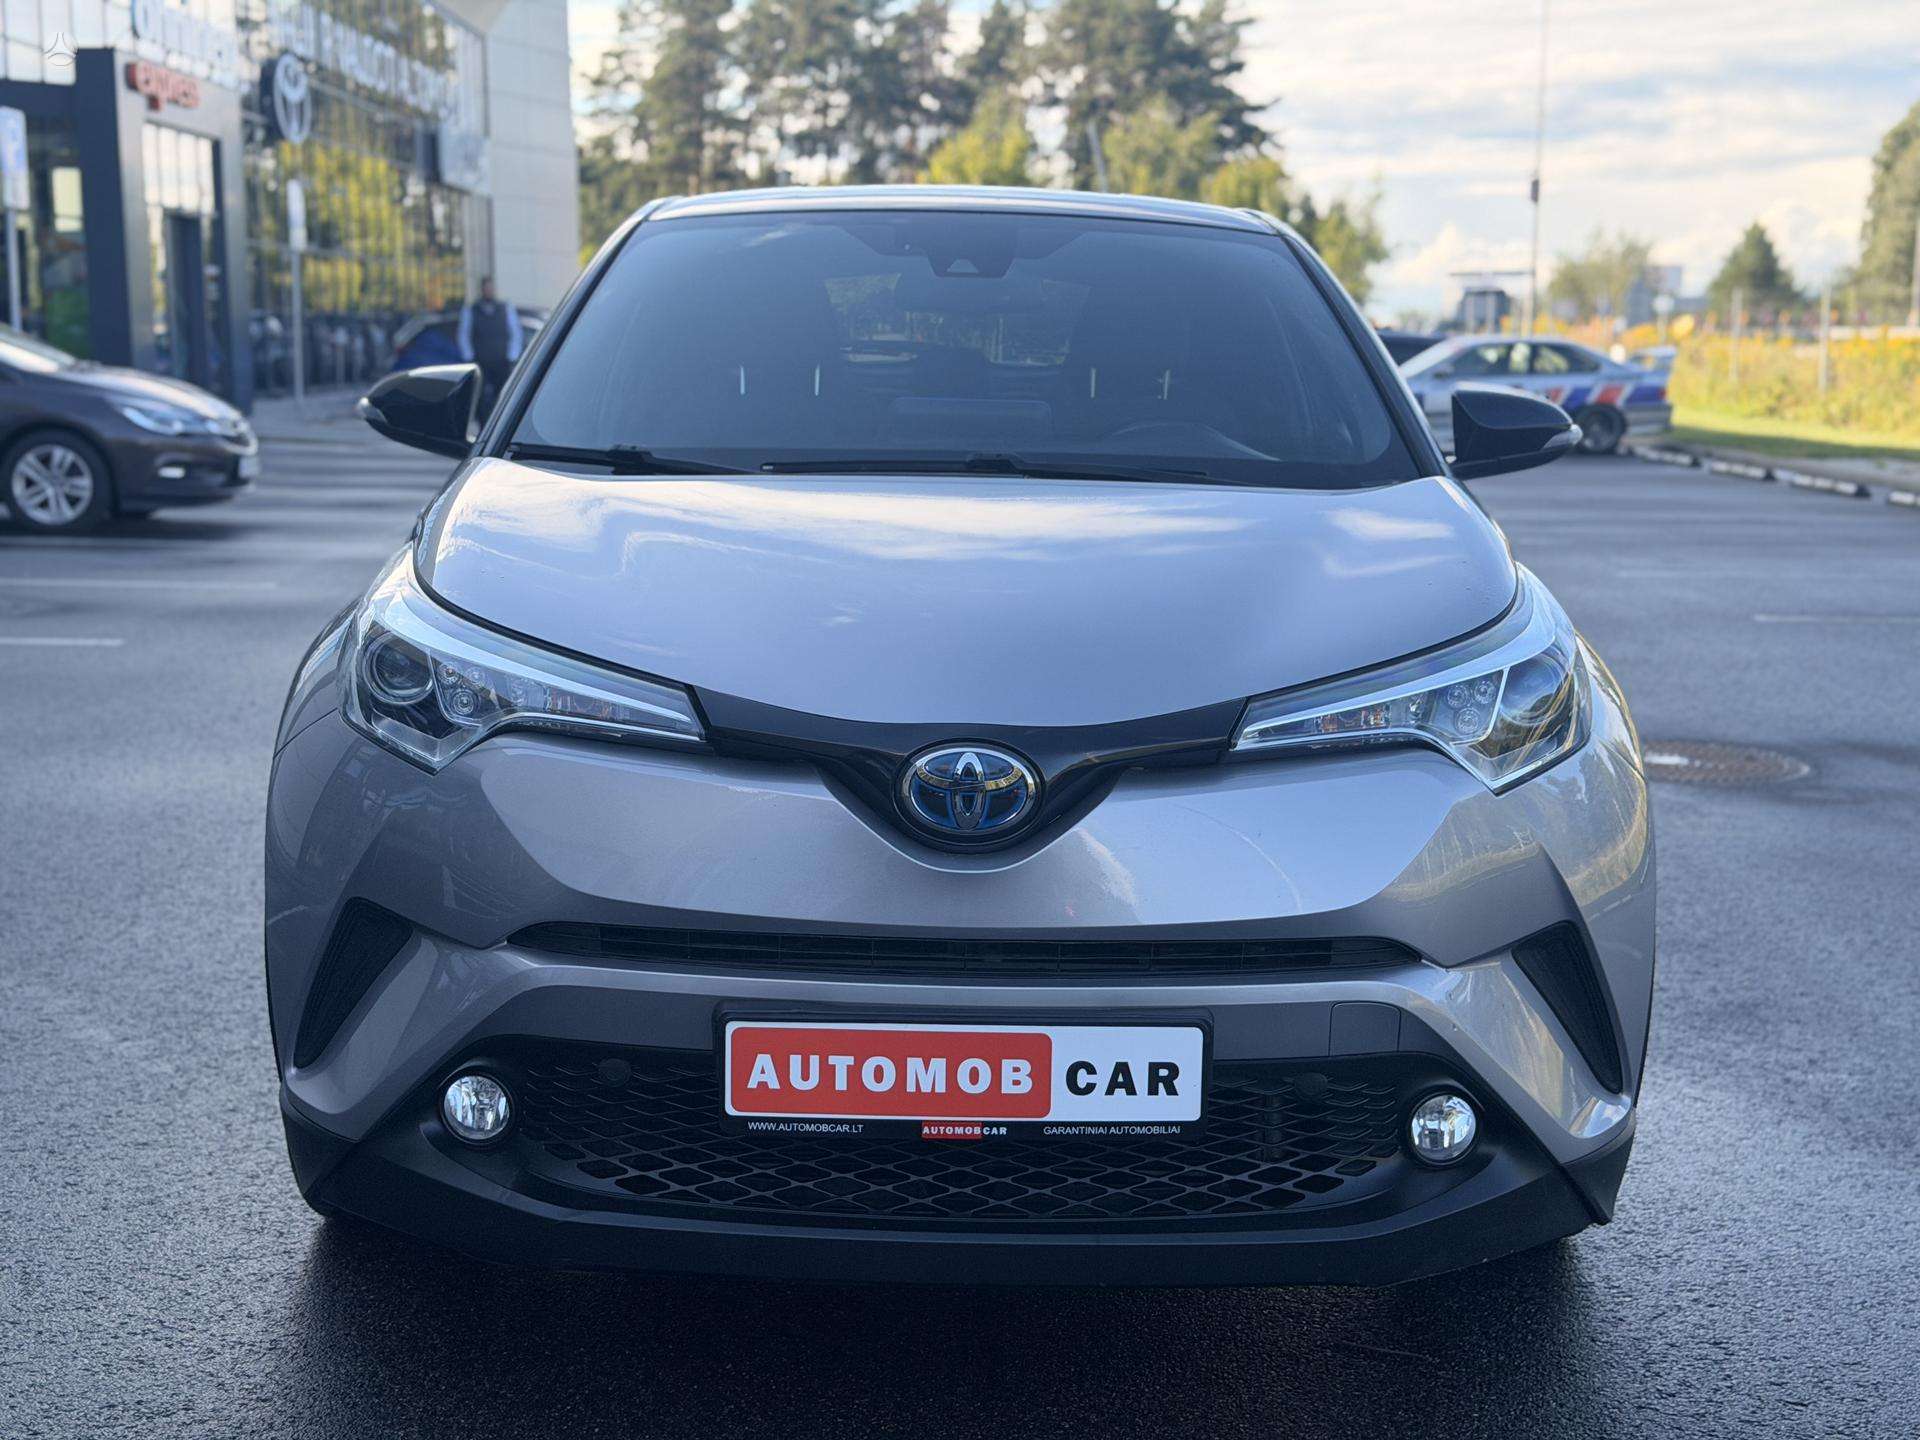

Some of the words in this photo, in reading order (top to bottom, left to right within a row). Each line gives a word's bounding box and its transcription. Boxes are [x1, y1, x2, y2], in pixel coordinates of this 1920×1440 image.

[747, 1053, 1034, 1094] AUTOMOB
[1065, 1061, 1180, 1097] CAR
[747, 1121, 865, 1133] WWW.AUTOMOBCAR.LT
[1042, 1125, 1108, 1136] GARANTINIAI
[1108, 1124, 1182, 1135] AUTOMOBILIAI
